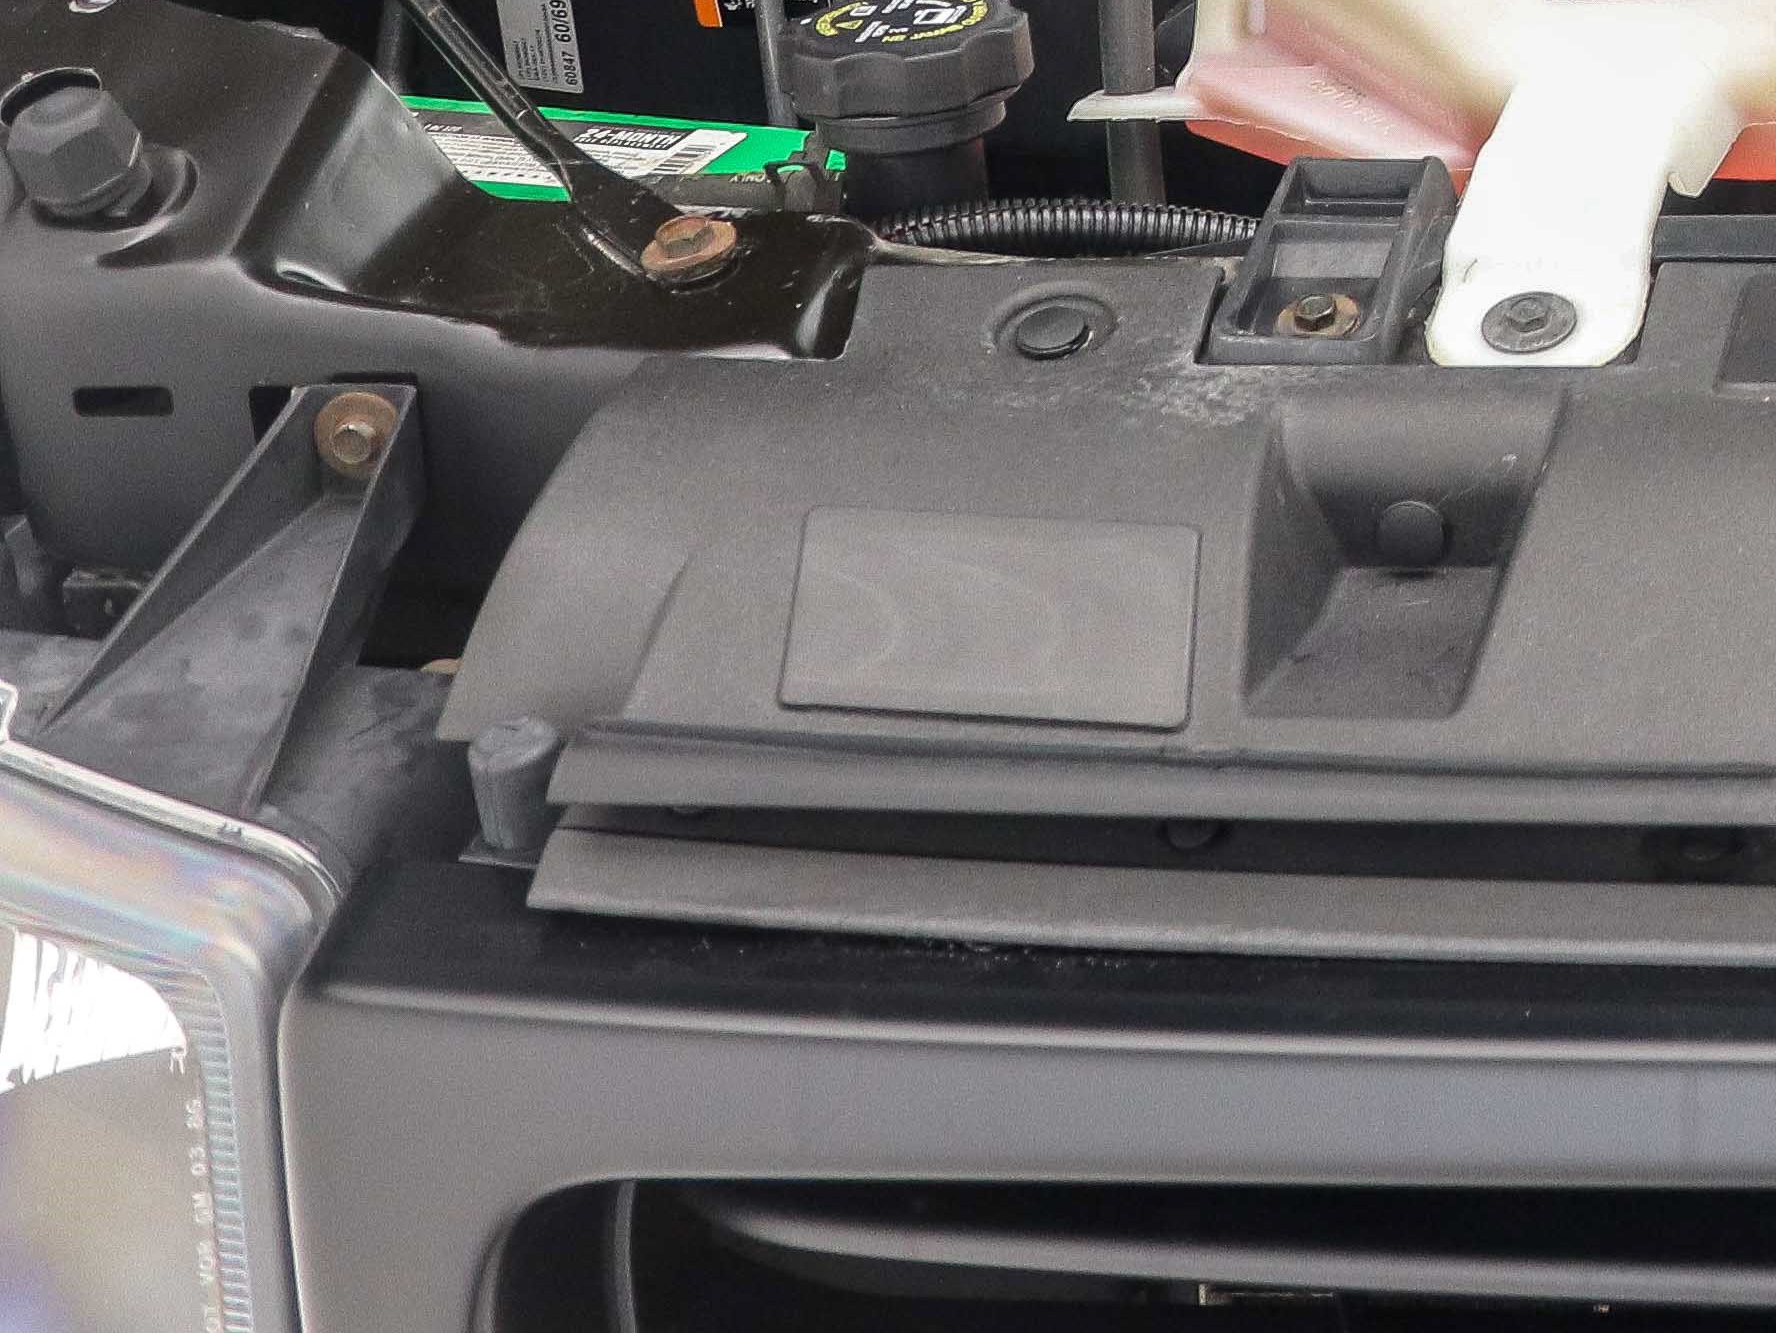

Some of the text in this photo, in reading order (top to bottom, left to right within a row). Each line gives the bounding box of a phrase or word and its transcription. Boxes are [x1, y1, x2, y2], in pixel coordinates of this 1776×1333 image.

[550, 0, 578, 86] 60847 60/69
[583, 128, 681, 145] 24-MONTH
